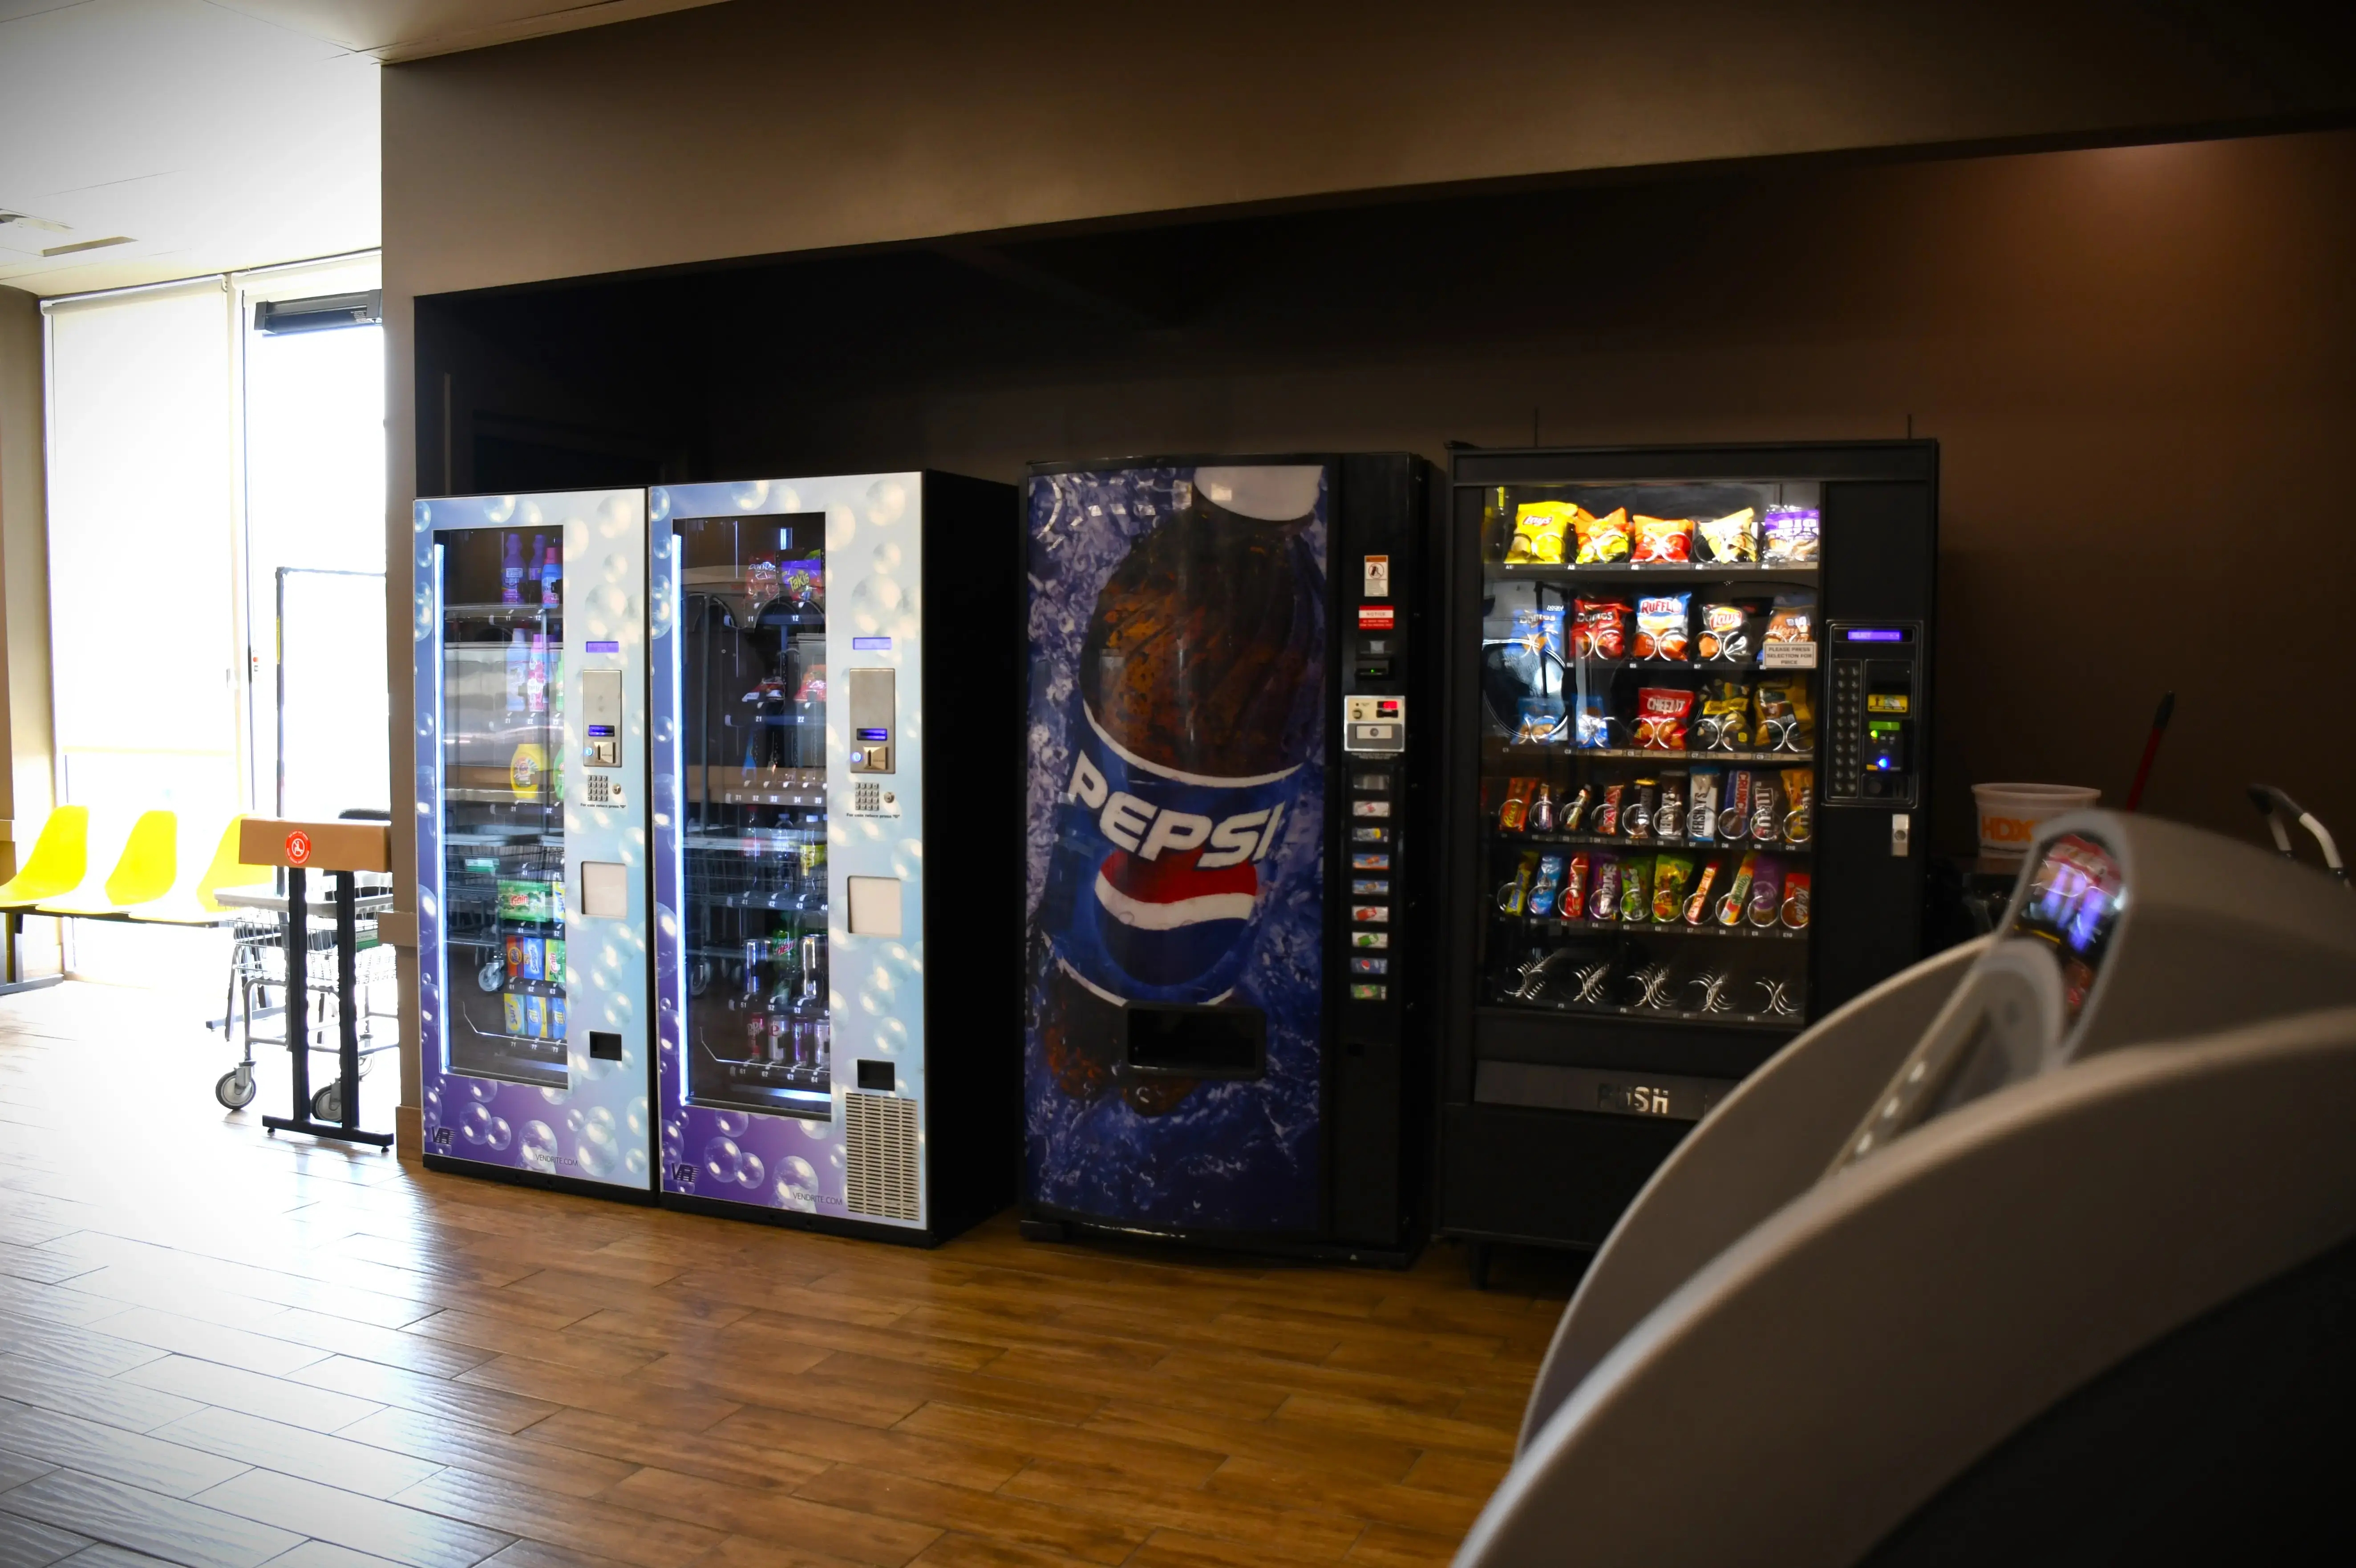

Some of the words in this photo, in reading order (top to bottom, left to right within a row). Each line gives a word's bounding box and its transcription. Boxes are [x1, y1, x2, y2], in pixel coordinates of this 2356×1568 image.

[789, 572, 810, 592] Takis
[1069, 749, 1286, 868] PEPSI
[1981, 816, 2035, 842] HDX
[511, 894, 529, 906] Gain
[535, 1154, 579, 1167] VENDRITE.COM
